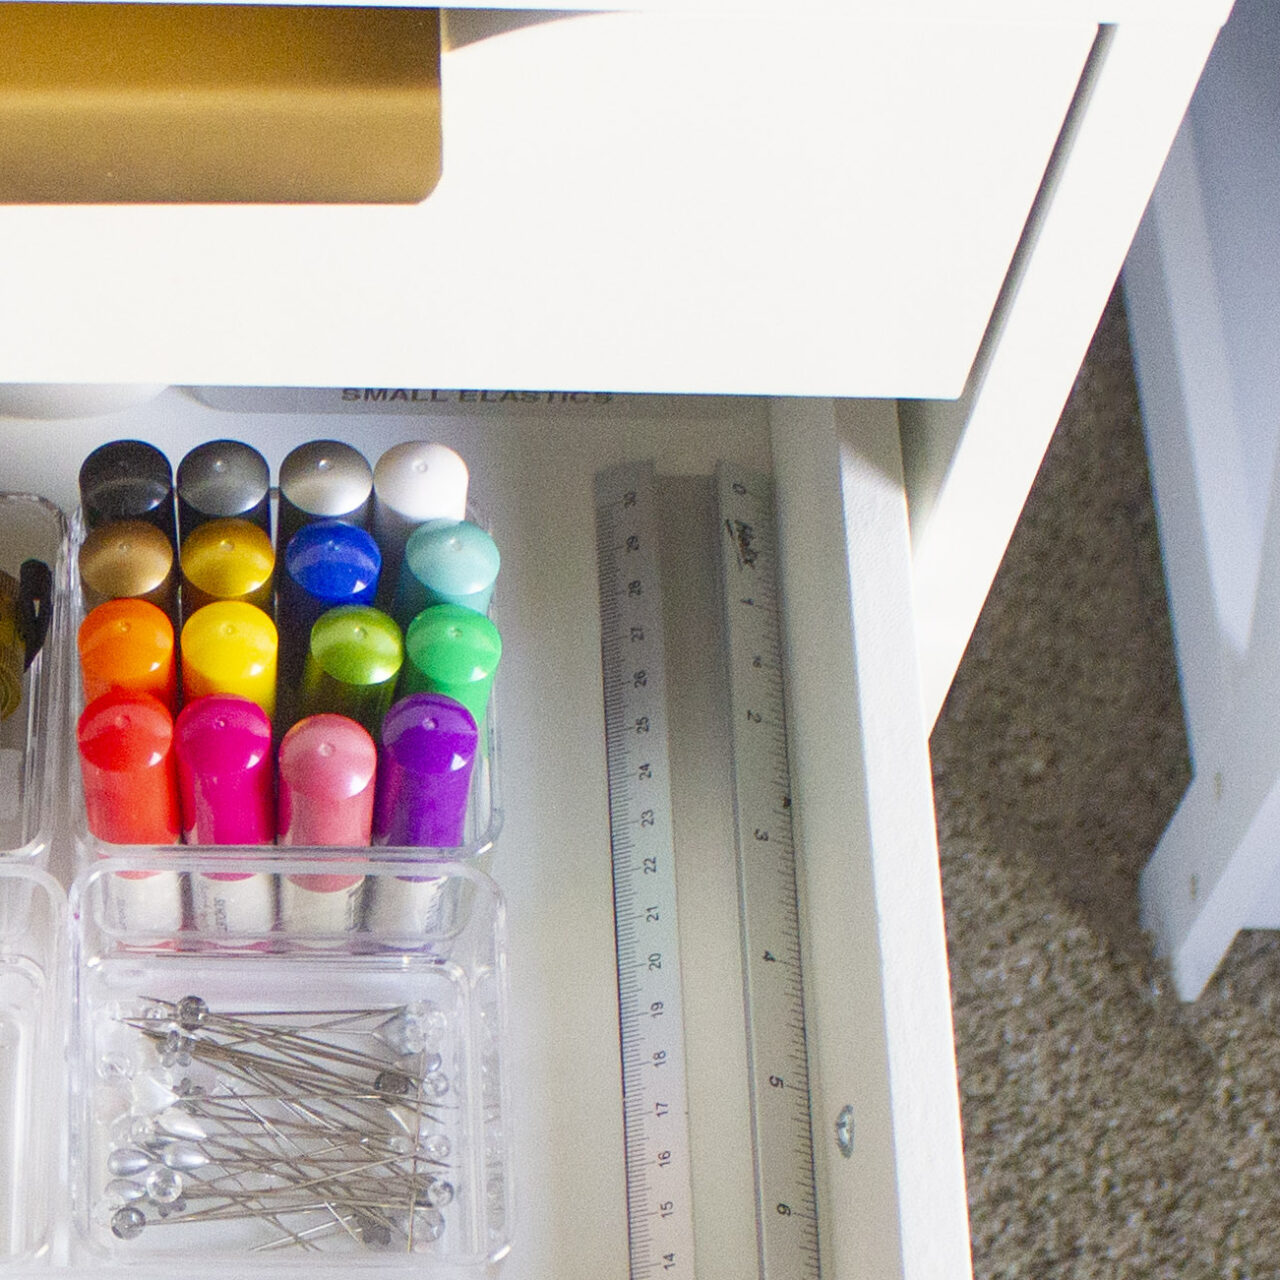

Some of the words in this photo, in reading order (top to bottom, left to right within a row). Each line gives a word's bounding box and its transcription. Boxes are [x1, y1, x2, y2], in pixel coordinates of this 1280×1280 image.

[341, 388, 447, 402] SMALL
[628, 580, 641, 597] 28
[630, 626, 644, 643] 27
[634, 670, 647, 688] 26
[636, 716, 650, 733] 25
[747, 710, 762, 724] 2
[639, 763, 652, 781] 24
[641, 809, 654, 827] 23
[754, 829, 769, 841] 3
[644, 856, 657, 875] 22
[646, 905, 659, 923] 21
[649, 952, 661, 970] 20
[762, 951, 776, 962] 4
[651, 1001, 664, 1019] 19
[653, 1050, 666, 1067] 18
[770, 1075, 784, 1089] 5
[656, 1102, 668, 1117] 17
[658, 1150, 671, 1168] 16
[660, 1201, 674, 1218] 15
[776, 1203, 791, 1217] 6
[663, 1253, 676, 1270] 14
